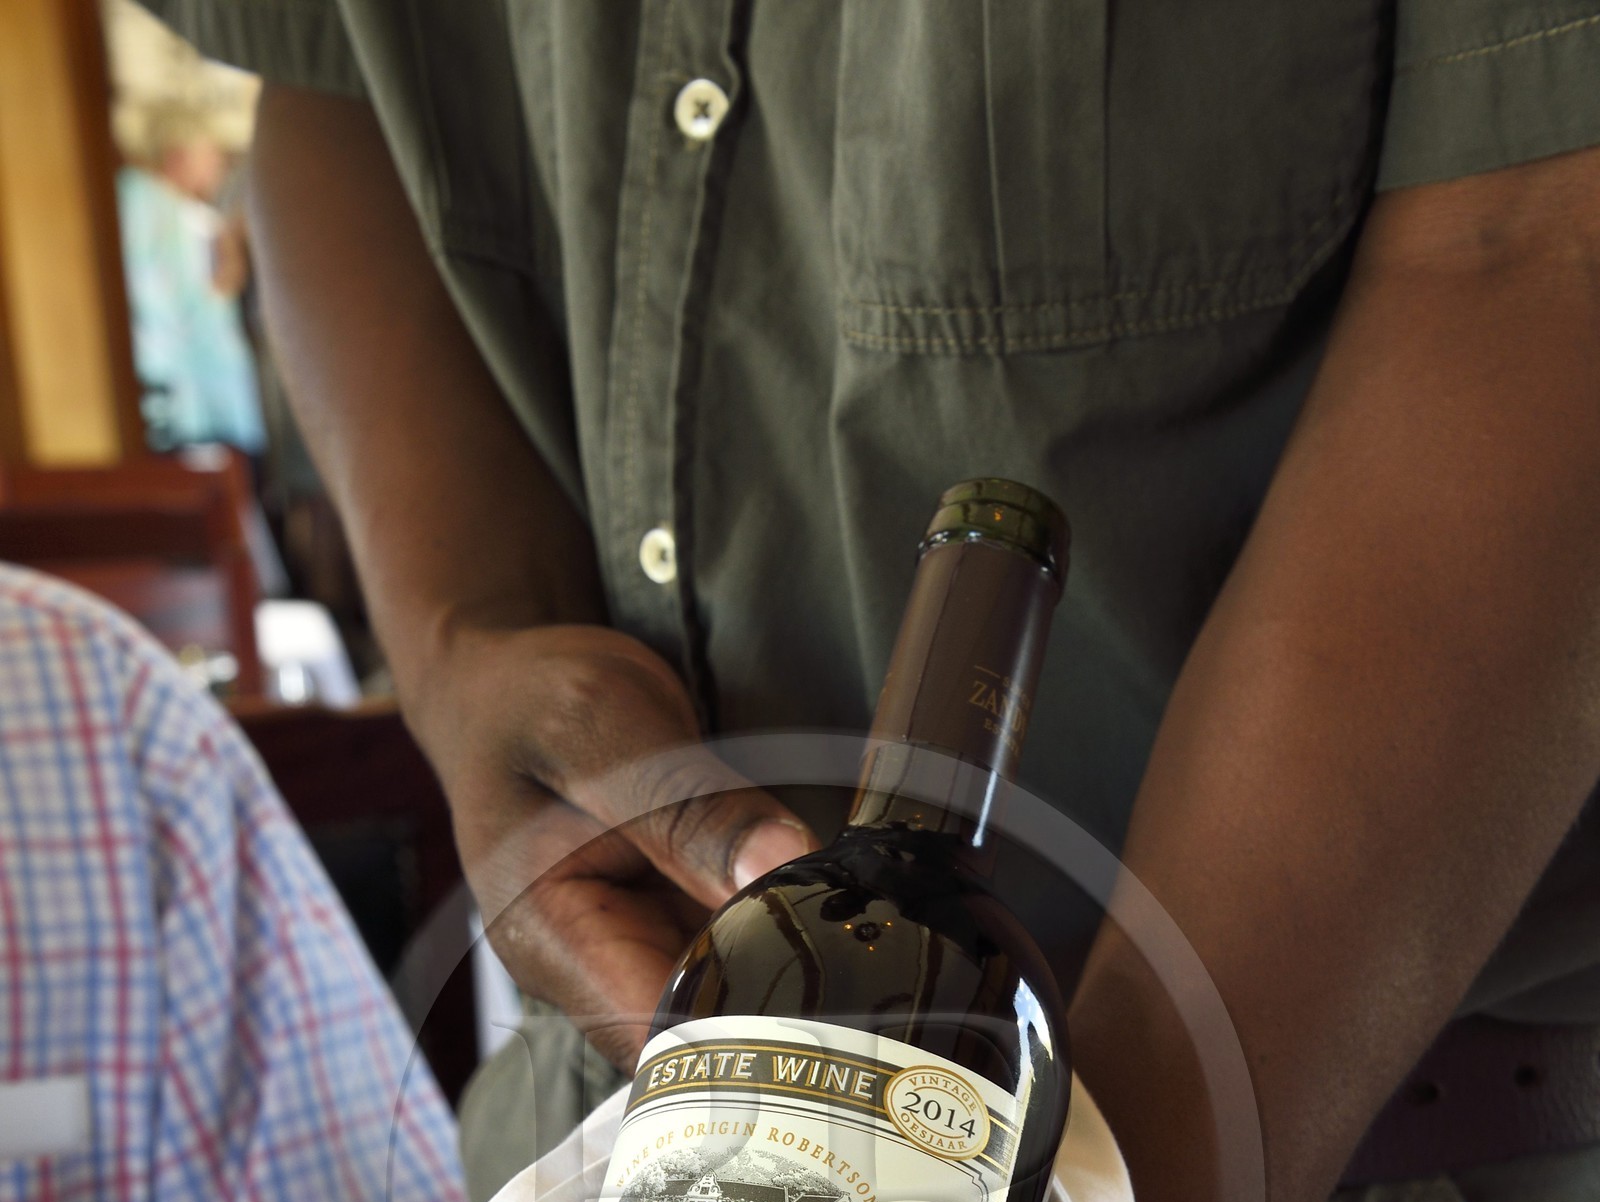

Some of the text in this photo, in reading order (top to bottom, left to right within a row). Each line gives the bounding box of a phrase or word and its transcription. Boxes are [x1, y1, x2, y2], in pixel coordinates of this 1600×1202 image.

[647, 1052, 877, 1099] ESTATE WINE
[908, 1075, 977, 1112] VINTAGE
[900, 1112, 968, 1150] OESJAAR
[901, 1092, 976, 1139] 2014
[616, 1146, 650, 1188] WINE
[655, 1131, 675, 1150] OF
[683, 1121, 757, 1138] ORIGIN
